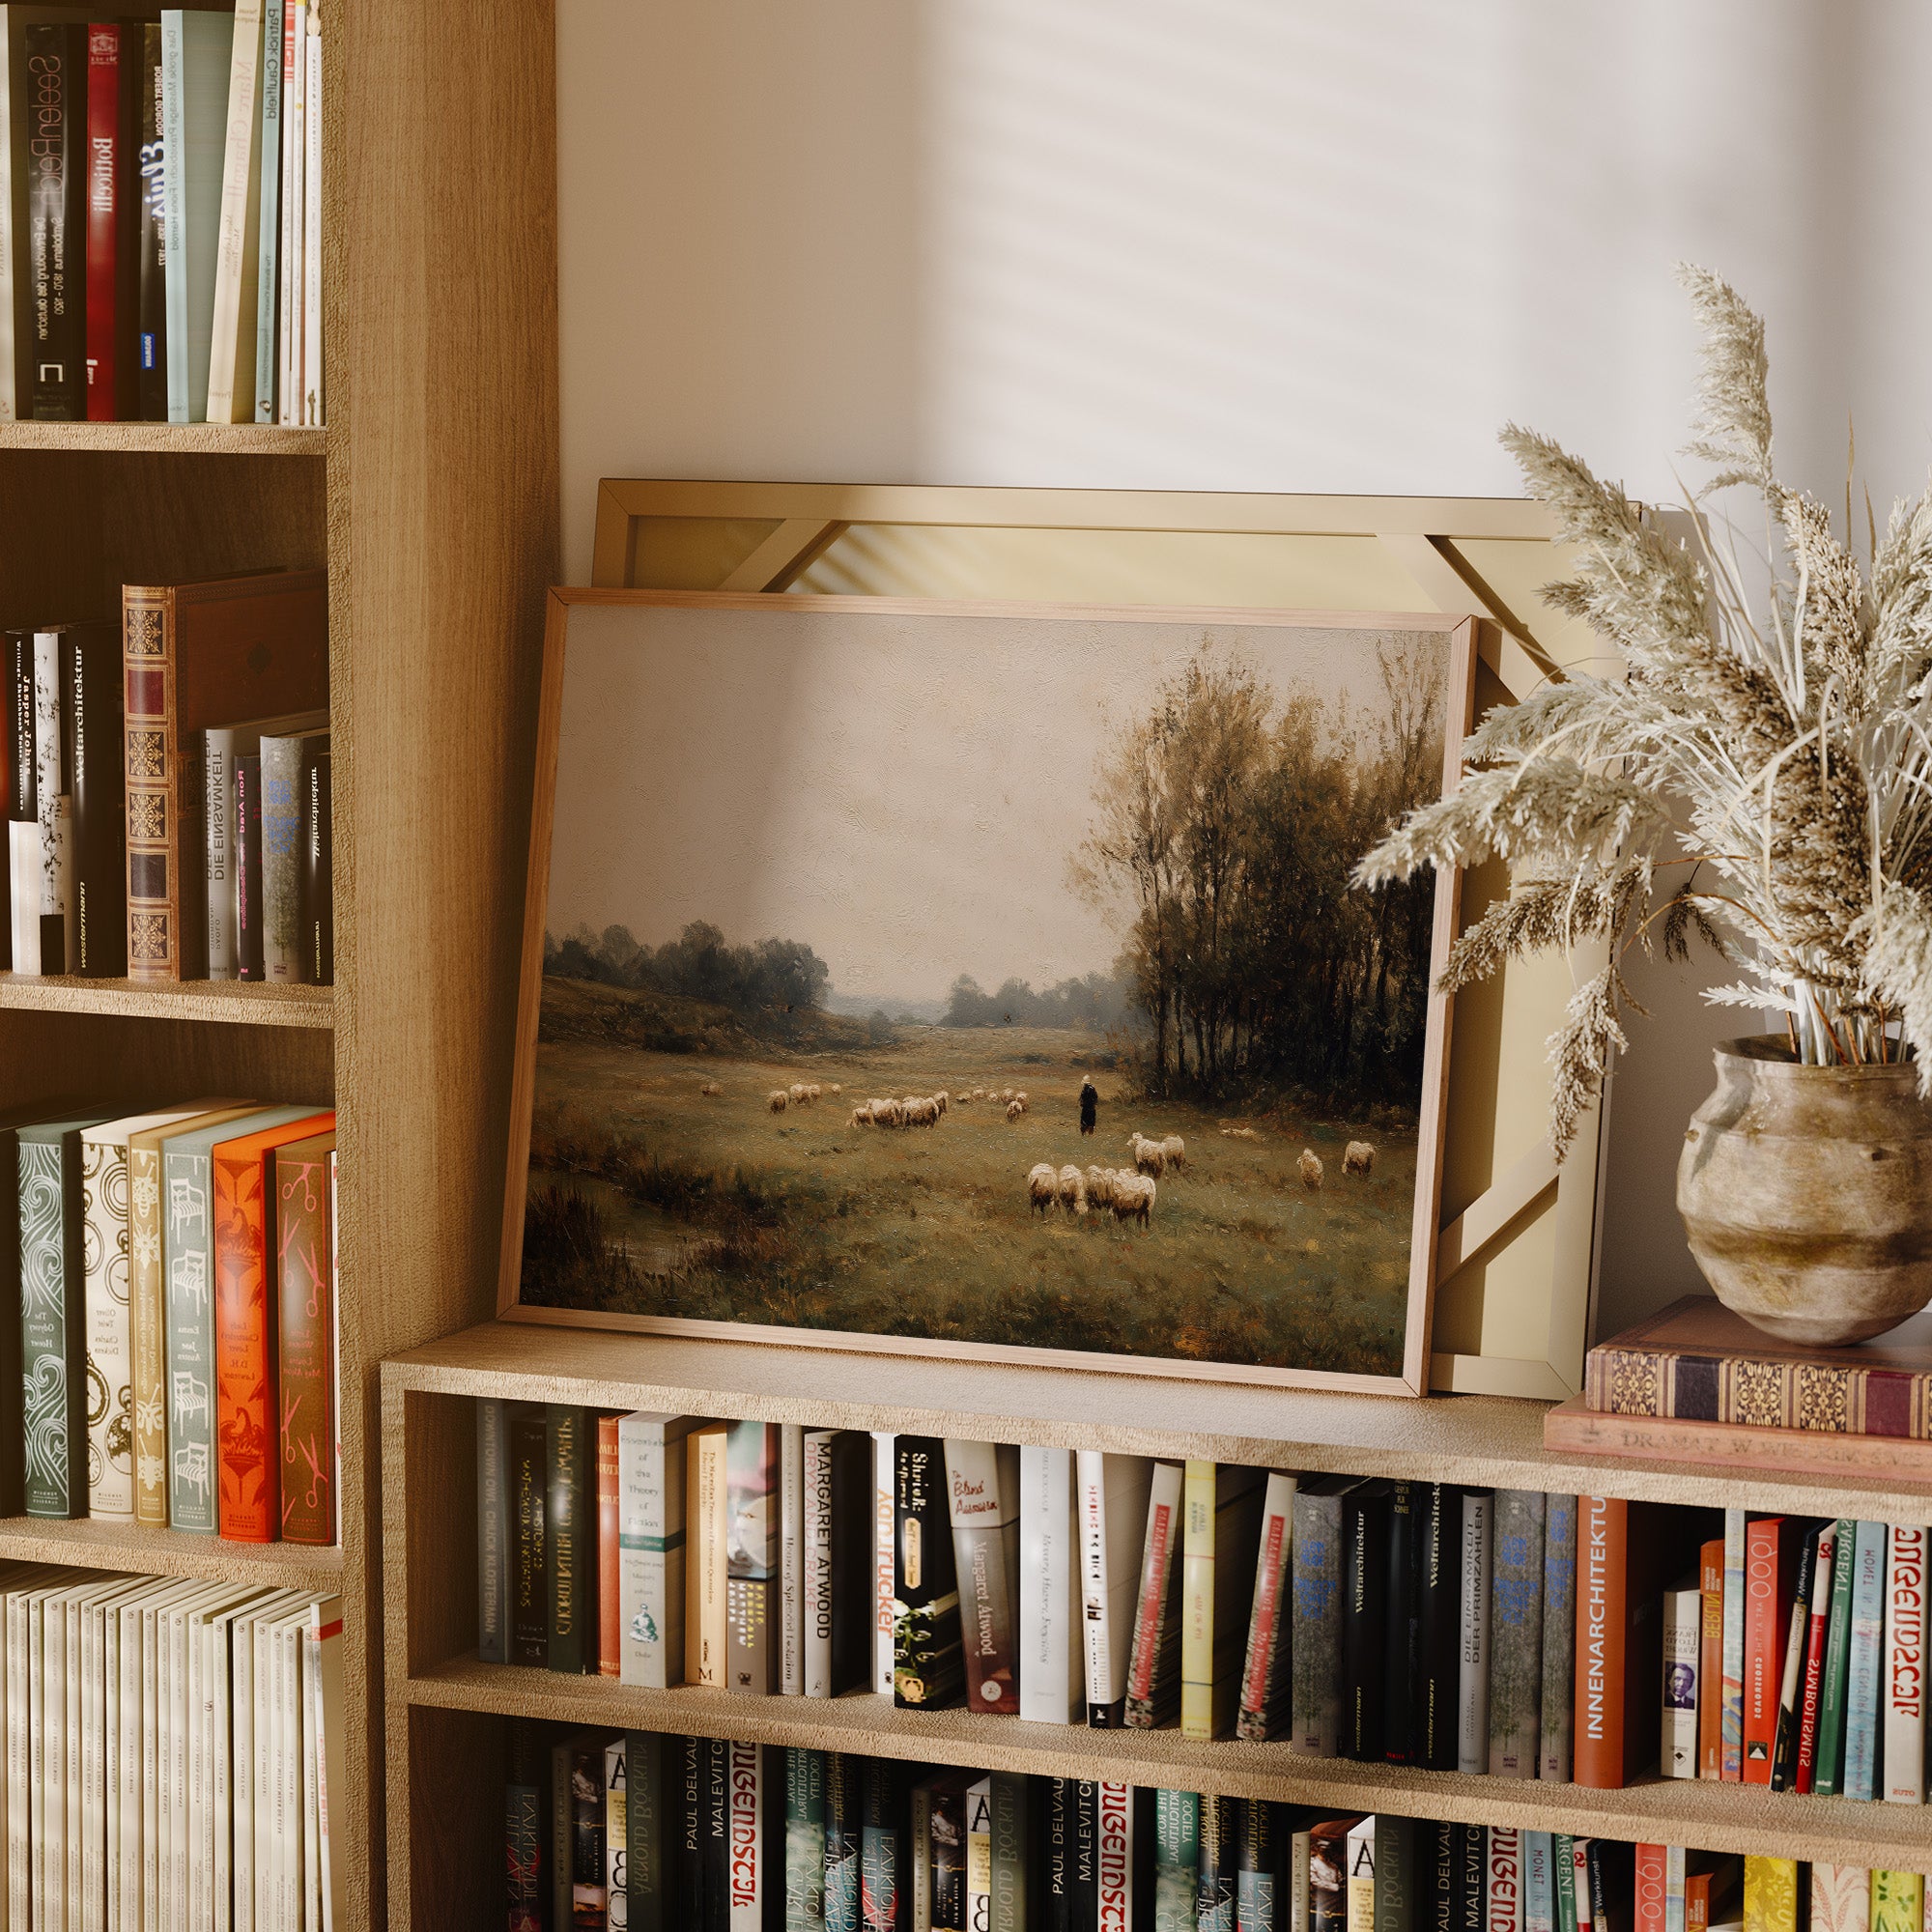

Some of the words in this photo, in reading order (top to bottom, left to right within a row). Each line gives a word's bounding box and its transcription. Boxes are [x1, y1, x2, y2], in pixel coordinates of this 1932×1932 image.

[74, 645, 85, 782] Weltarchitektur
[485, 1406, 496, 1476] DOWNTOWN
[806, 1441, 816, 1491] ORYX
[485, 1479, 496, 1505] OWL
[629, 1485, 659, 1496] Theory
[636, 1469, 650, 1478] the
[817, 1442, 831, 1550] MARGARET
[954, 1480, 984, 1496] Blind
[485, 1511, 496, 1551] CHUCK
[628, 1518, 659, 1528] Fiction
[806, 1497, 816, 1540] AND
[806, 1548, 816, 1612] CRAKE
[972, 1541, 990, 1601] Margaret
[1355, 1511, 1364, 1613] Weltarchitektur
[1474, 1506, 1483, 1621] PRIMZAHLEN
[484, 1554, 496, 1634] KLOSTERMAN
[817, 1557, 831, 1639] ATWOOD
[1587, 1496, 1606, 1740] INNENARCHITEKTU
[978, 1605, 997, 1656] Atwood
[698, 1667, 713, 1681] M
[687, 1807, 697, 1850] PAUL
[1053, 1852, 1065, 1894] PAUL
[1533, 1849, 1545, 1885] MONET
[1558, 1833, 1573, 1898] ARGENT
[1592, 1861, 1603, 1908] Werkkunst
[1636, 1856, 1662, 1919] 1900
